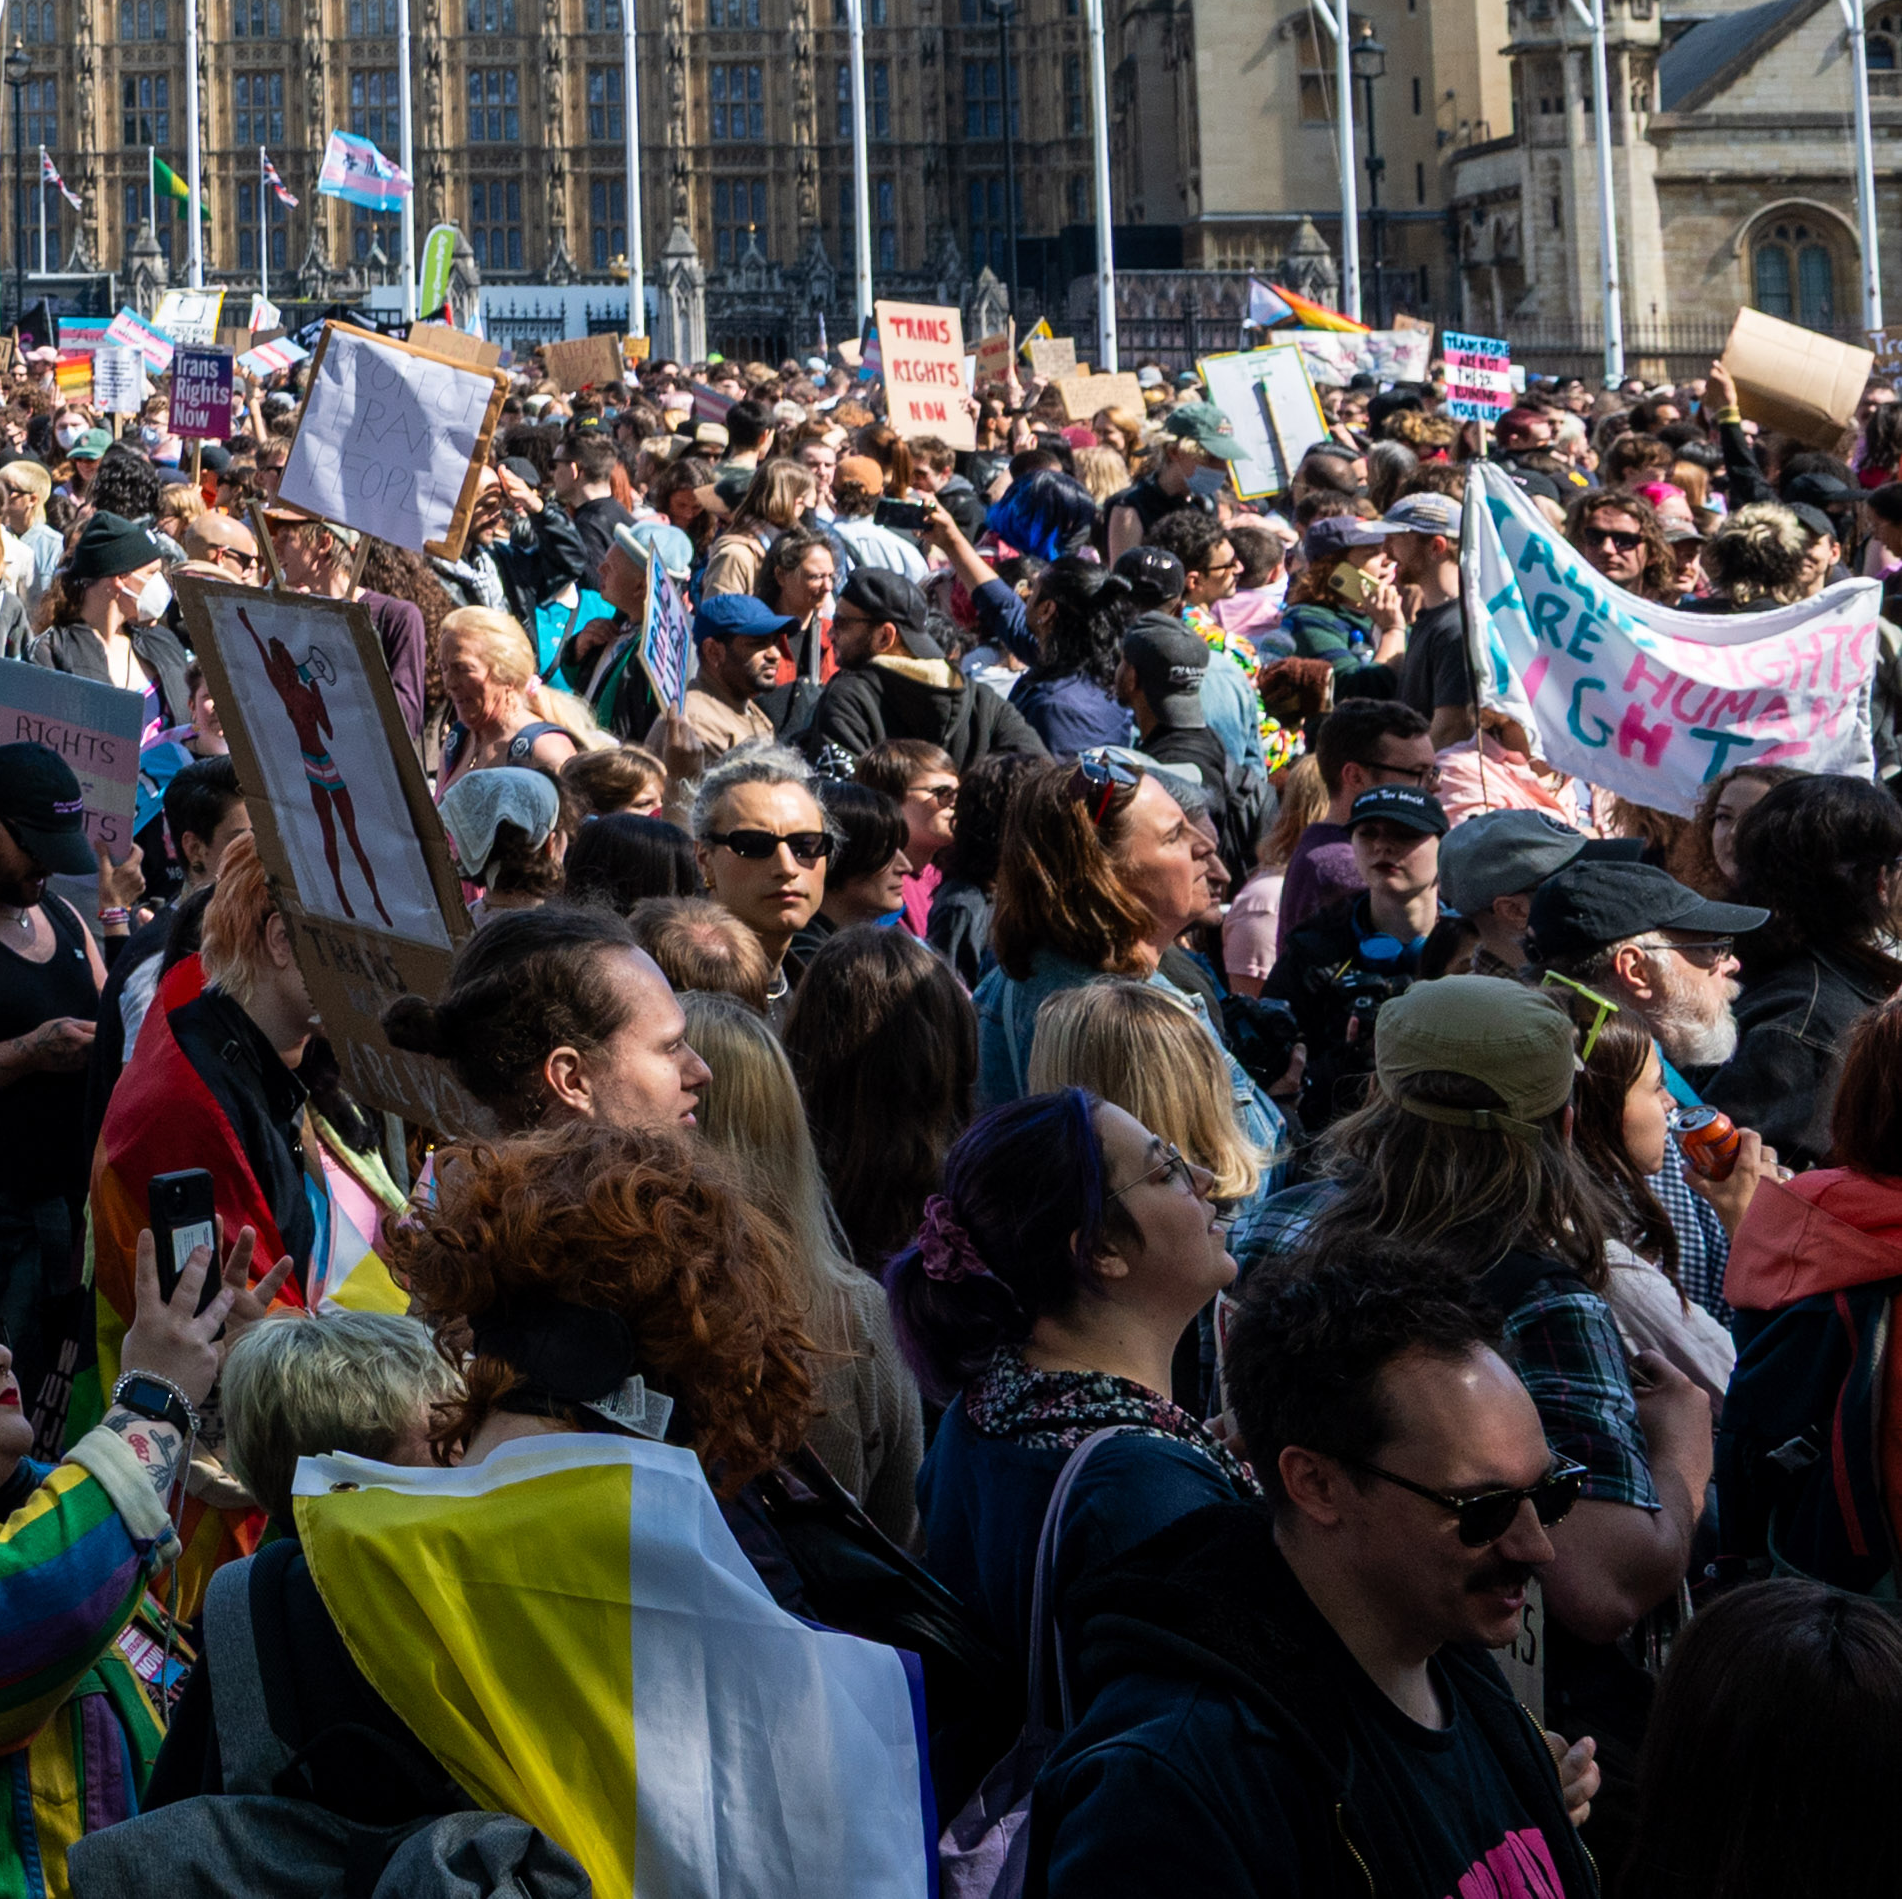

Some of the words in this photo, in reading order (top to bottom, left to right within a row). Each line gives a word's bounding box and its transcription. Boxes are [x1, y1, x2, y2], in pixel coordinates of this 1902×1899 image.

[889, 316, 950, 344] TRANS
[175, 353, 219, 378] Trans
[331, 338, 479, 423] PROTECT
[893, 359, 959, 387] RIGHTS
[176, 377, 230, 406] Rights
[909, 401, 947, 421] NOW
[1452, 402, 1478, 420] YOUR
[173, 402, 210, 428] Now
[331, 393, 472, 463] TRANS
[307, 441, 445, 520] PEOPLE
[1671, 621, 1877, 691] RIGHTS
[1622, 652, 1848, 740] HUMAN
[16, 714, 116, 765] RIGHTS
[301, 922, 409, 995] TRANS
